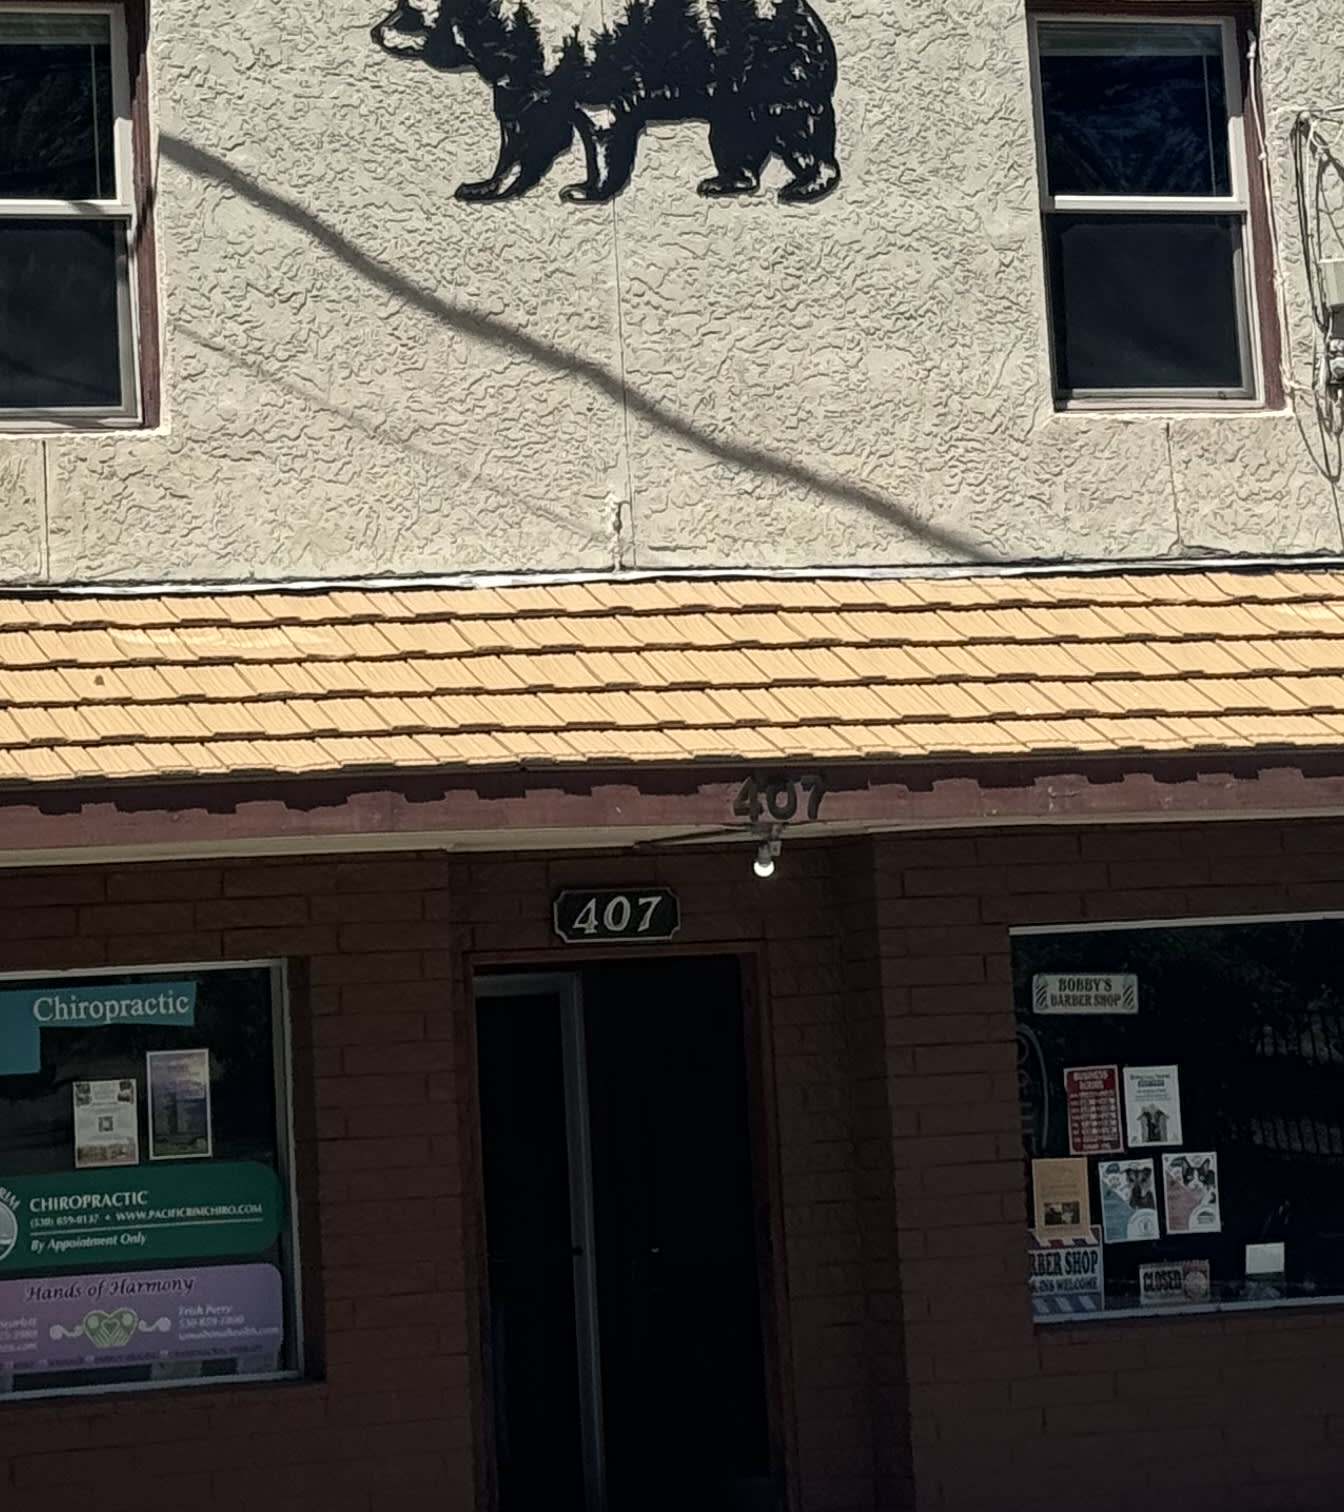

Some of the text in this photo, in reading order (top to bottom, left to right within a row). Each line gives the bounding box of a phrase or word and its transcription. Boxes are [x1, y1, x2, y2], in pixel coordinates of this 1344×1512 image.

[734, 774, 825, 820] 407
[572, 895, 663, 935] 407
[1058, 977, 1112, 992] BOBBY'S
[33, 990, 190, 1024] Chiropractic
[1050, 993, 1121, 1007] BARBER SHOP
[29, 1190, 149, 1213] CHIROPRACTIC
[30, 1231, 147, 1254] By Appointment Only
[1029, 1249, 1098, 1276] RBER SHOP
[26, 1277, 194, 1302] Hands of Harmony
